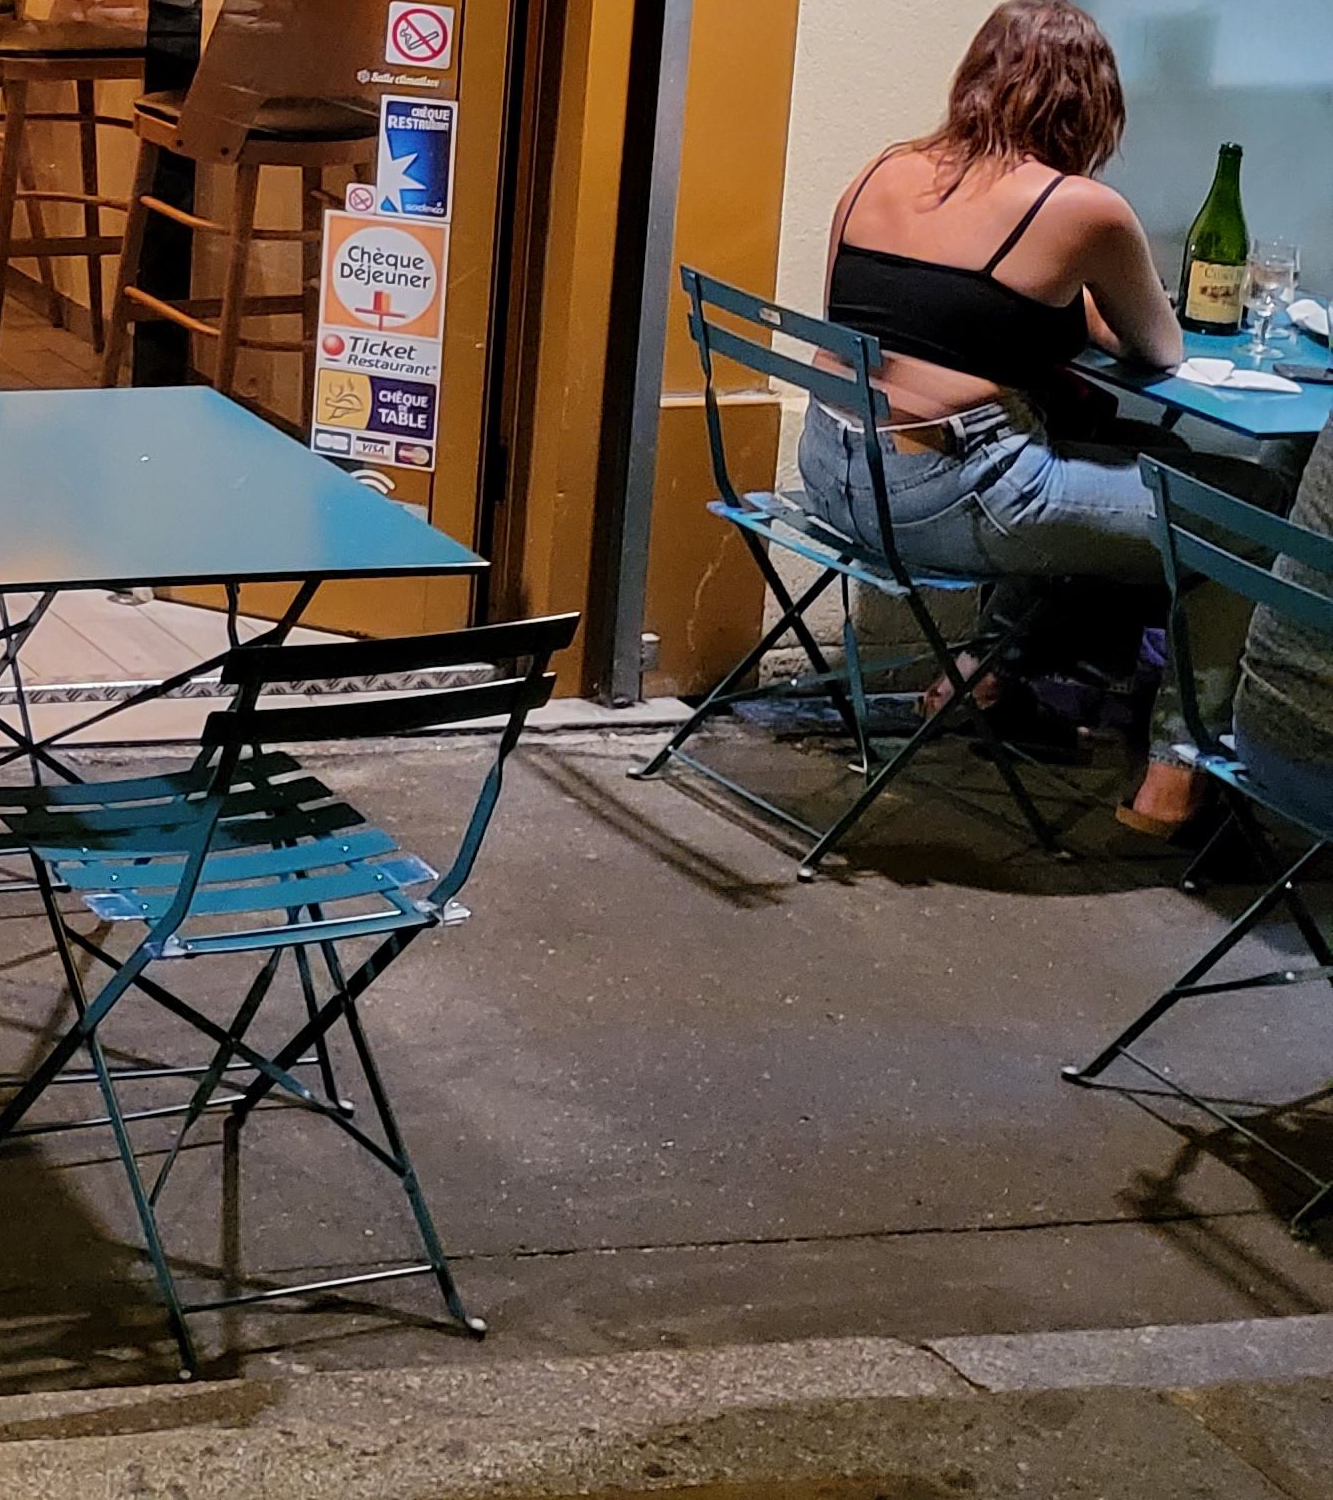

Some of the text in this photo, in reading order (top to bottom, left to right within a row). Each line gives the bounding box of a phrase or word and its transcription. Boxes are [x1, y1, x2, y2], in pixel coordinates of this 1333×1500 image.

[347, 245, 425, 271] Chèque
[340, 262, 431, 289] Déjeuner
[349, 336, 417, 360] Ticket
[378, 390, 429, 408] CHÈQUE
[377, 408, 429, 429] TABLE
[362, 443, 385, 453] VISA
